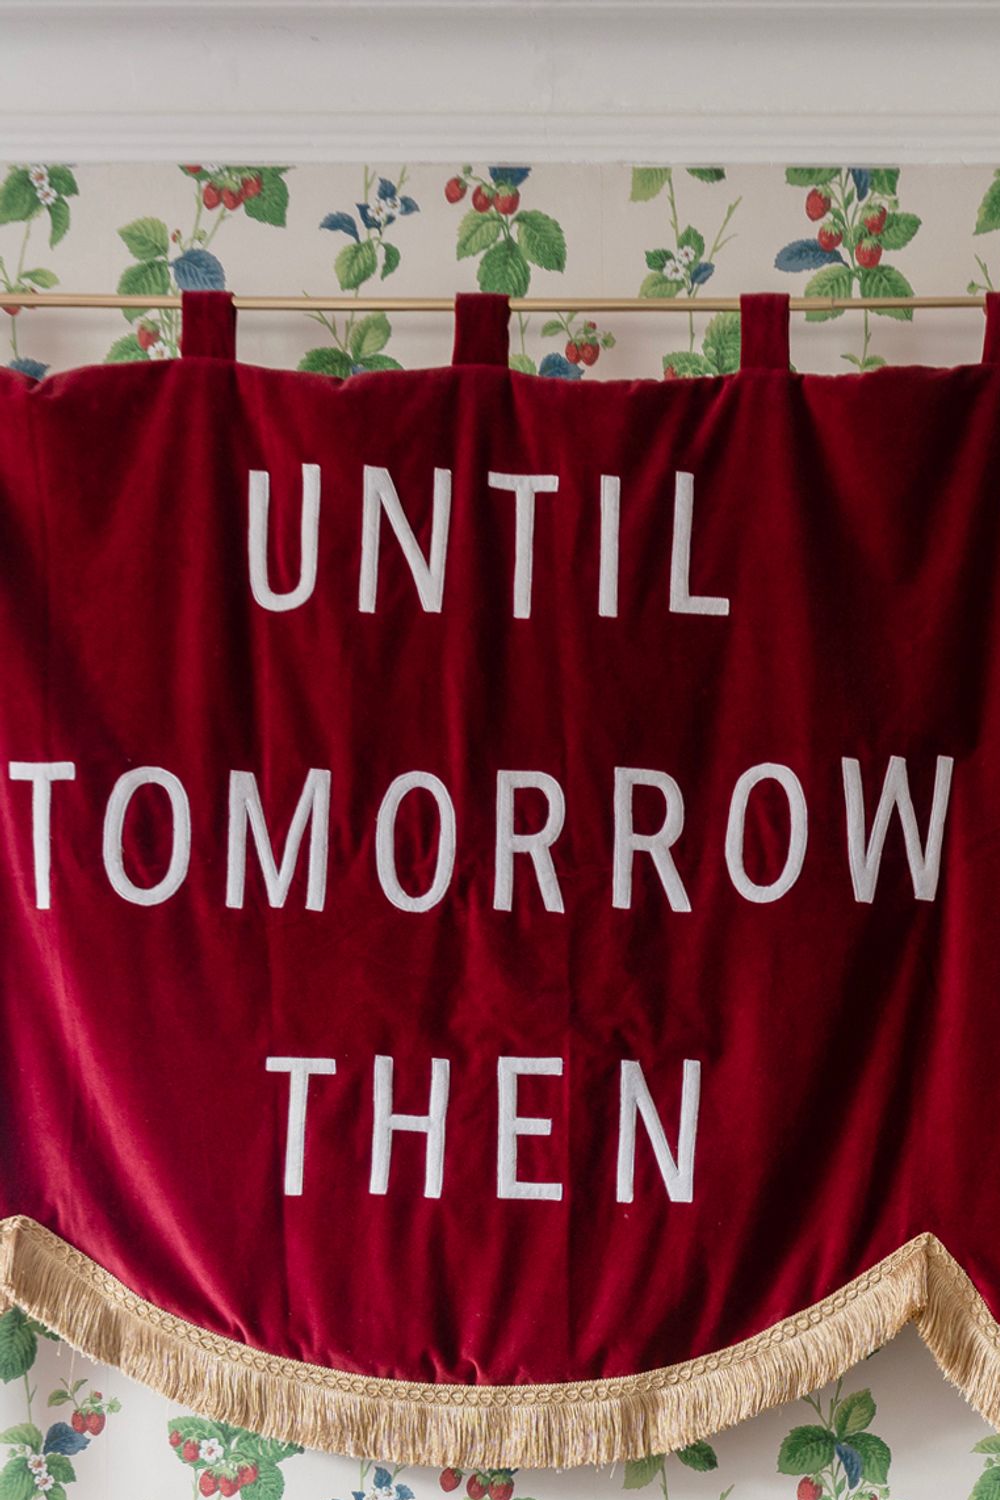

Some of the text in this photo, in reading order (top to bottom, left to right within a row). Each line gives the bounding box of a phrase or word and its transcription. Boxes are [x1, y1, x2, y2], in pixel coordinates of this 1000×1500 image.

[248, 463, 730, 619] UNTIL
[8, 755, 954, 914] TOMORROW
[265, 1054, 701, 1204] THEN
